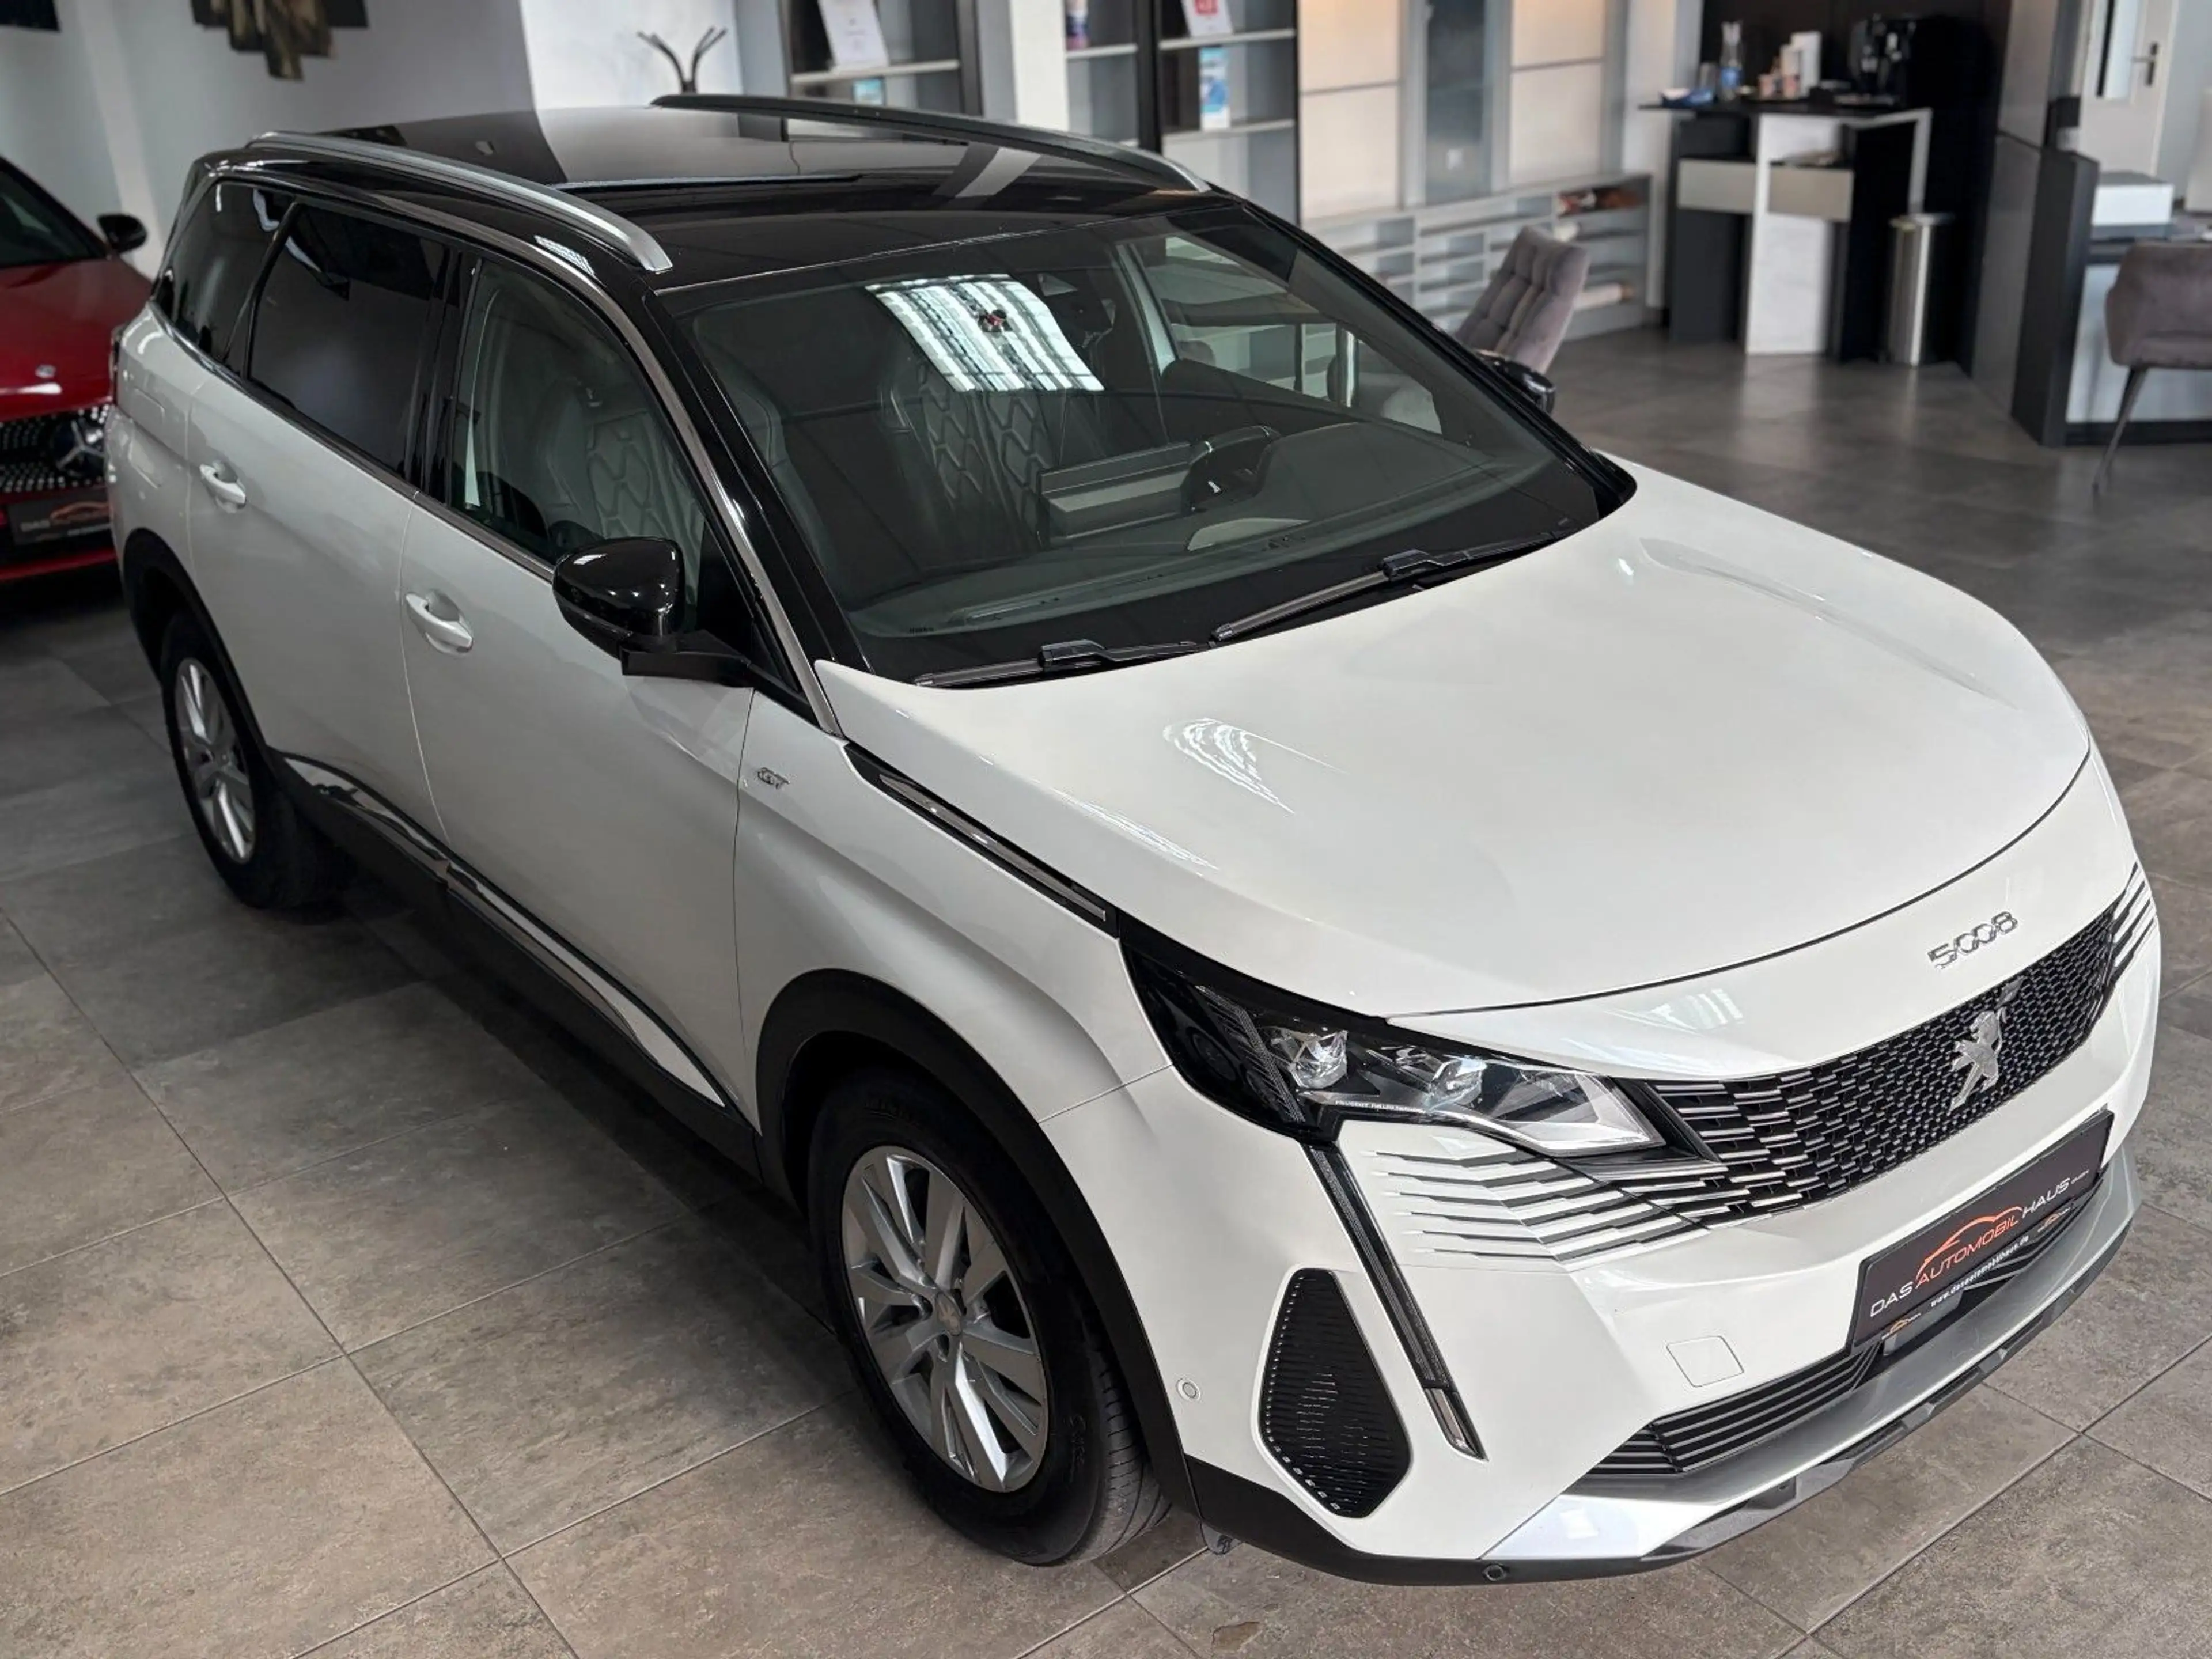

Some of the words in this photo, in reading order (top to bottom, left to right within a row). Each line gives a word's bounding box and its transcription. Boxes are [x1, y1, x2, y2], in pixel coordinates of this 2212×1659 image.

[757, 767, 790, 790] GT
[1927, 911, 2018, 969] 5008
[1870, 1281, 1914, 1317] DAS
[1915, 1215, 2019, 1289] AUTOMOBIL
[2022, 1177, 2071, 1219] HAUS
